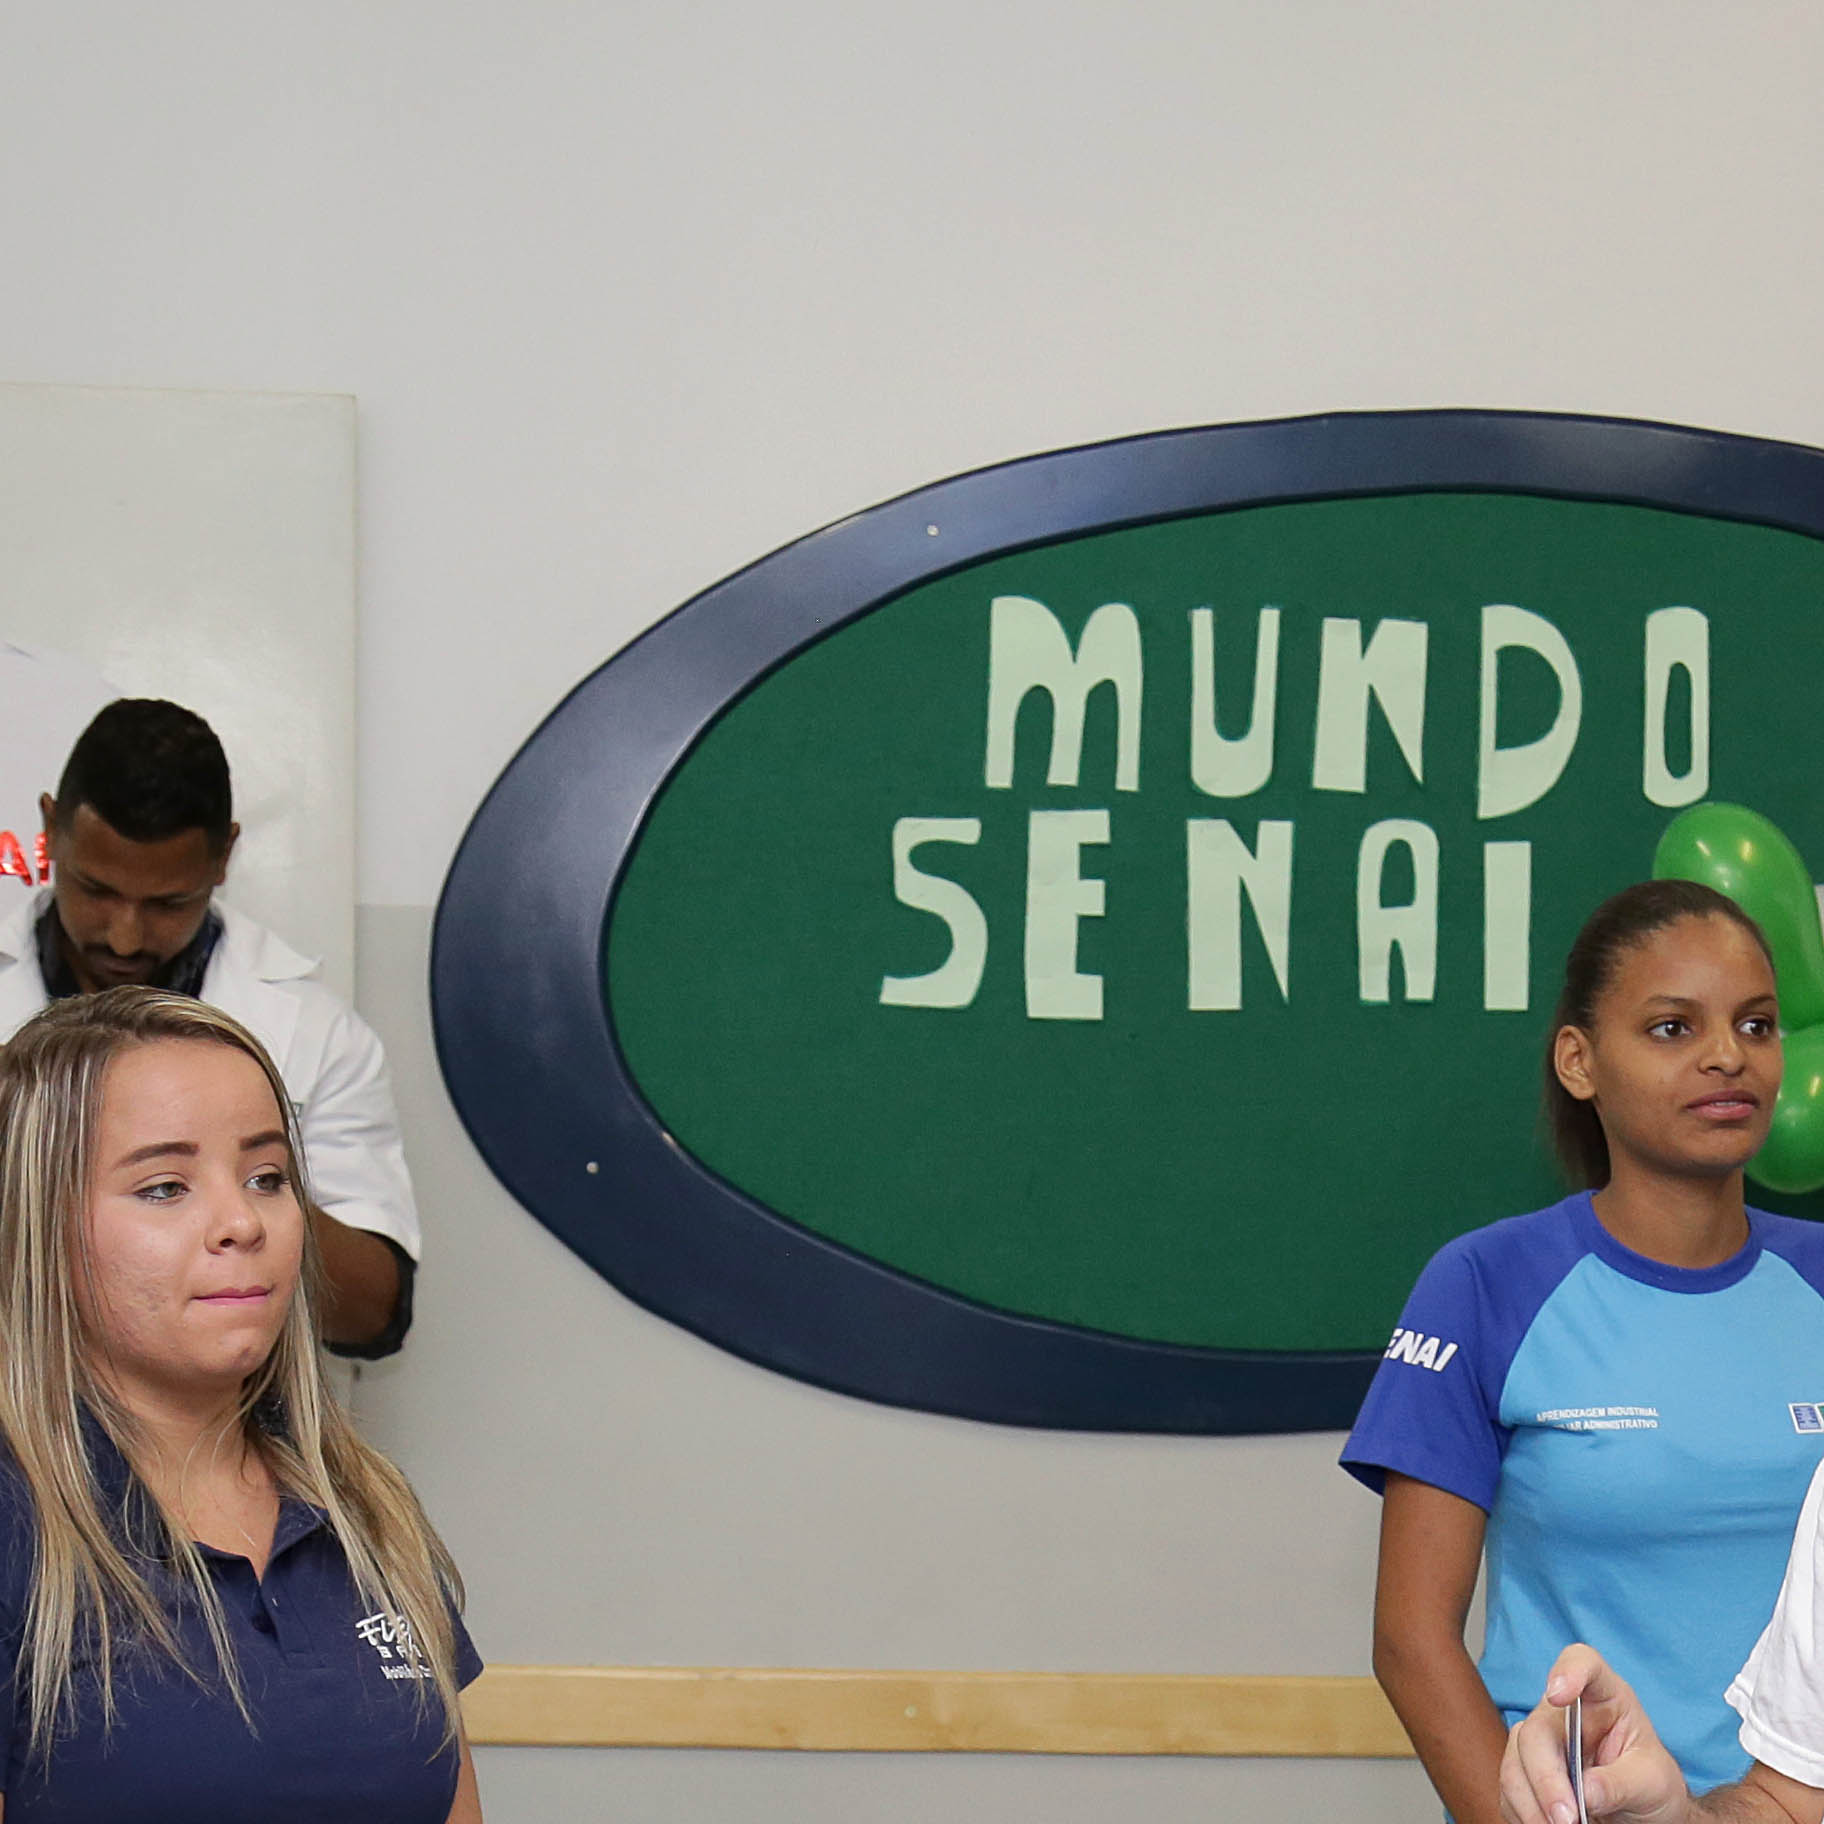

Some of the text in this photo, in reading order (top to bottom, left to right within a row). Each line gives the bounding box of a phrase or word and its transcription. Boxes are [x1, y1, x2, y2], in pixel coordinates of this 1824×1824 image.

[983, 595, 1711, 820] MUNDO
[878, 808, 1532, 1021] SENAI
[1607, 1406, 1659, 1417] INDUSTRIAL
